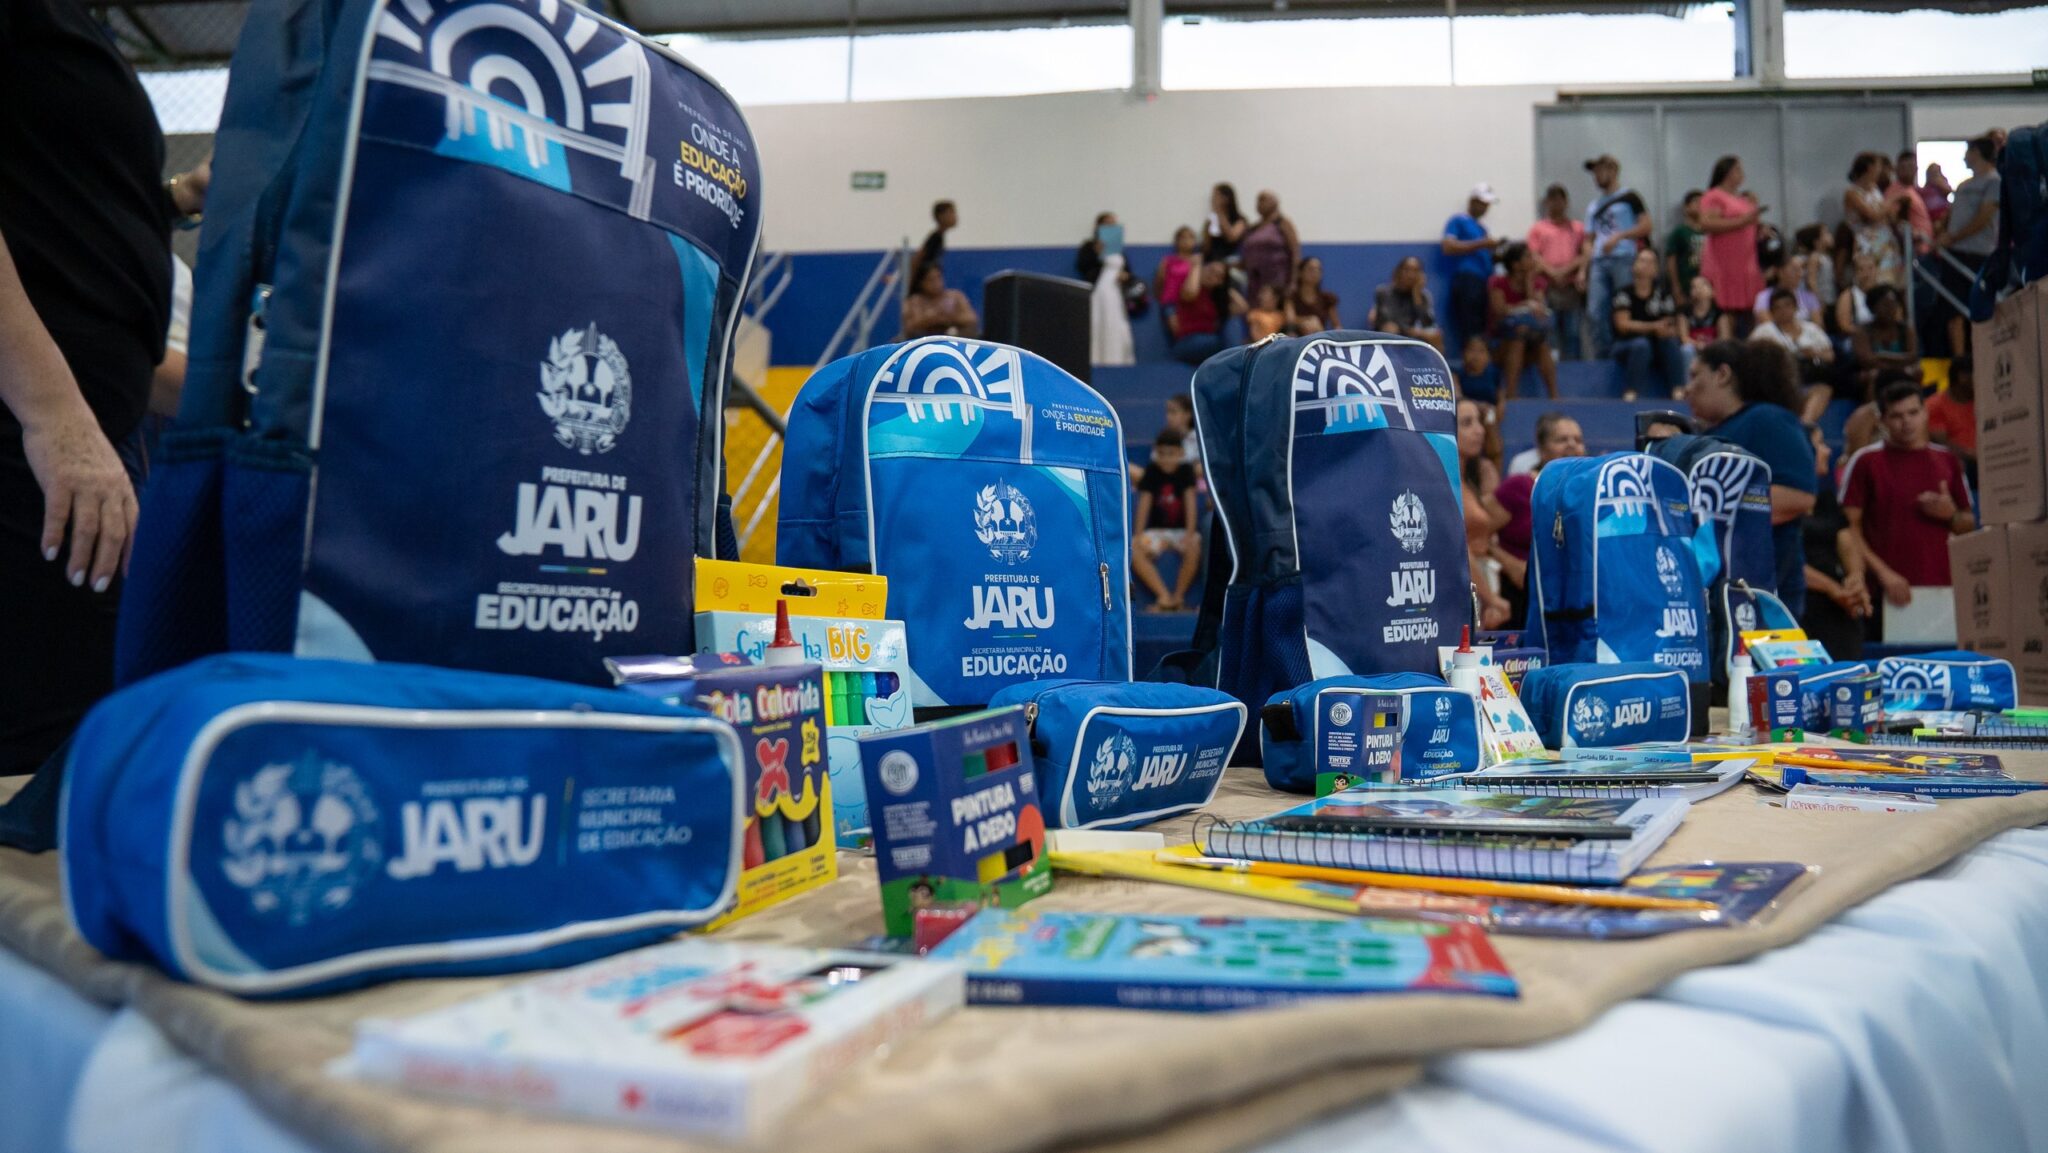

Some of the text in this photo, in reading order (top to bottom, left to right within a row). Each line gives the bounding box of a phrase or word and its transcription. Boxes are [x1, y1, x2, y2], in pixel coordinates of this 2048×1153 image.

[691, 122, 741, 168] ONDE A
[673, 159, 685, 187] É
[681, 140, 747, 199] EDUCAÇÃO
[1411, 374, 1439, 385] ONDE
[1041, 408, 1114, 428] ONDE A EDUCAÇÃO
[1055, 419, 1106, 437] É PRIORIDADE
[542, 466, 627, 491] PREFEITURA DE
[496, 482, 643, 562] JARU
[984, 574, 1040, 584] PREFEITURA DE
[1386, 569, 1436, 607] JARU
[475, 591, 640, 642] EDUCAÇÃO
[963, 585, 1055, 630] JARU
[1655, 608, 1698, 637] JARU
[826, 626, 872, 663] BIG
[1383, 618, 1439, 644] EDUCAÇÃO
[962, 648, 1067, 680] EDUCAÇÃO
[1505, 656, 1541, 672] Colorida
[757, 680, 820, 720] Colorida
[1611, 701, 1651, 728] JARU
[1366, 734, 1393, 749] PINTURA
[1429, 728, 1450, 743] JARU
[1132, 753, 1188, 791] JARU
[1368, 750, 1391, 766] A DEDO
[951, 782, 1016, 826] PINTURA
[387, 793, 547, 880] JARU
[963, 825, 979, 854] A
[977, 811, 1017, 848] DEDO
